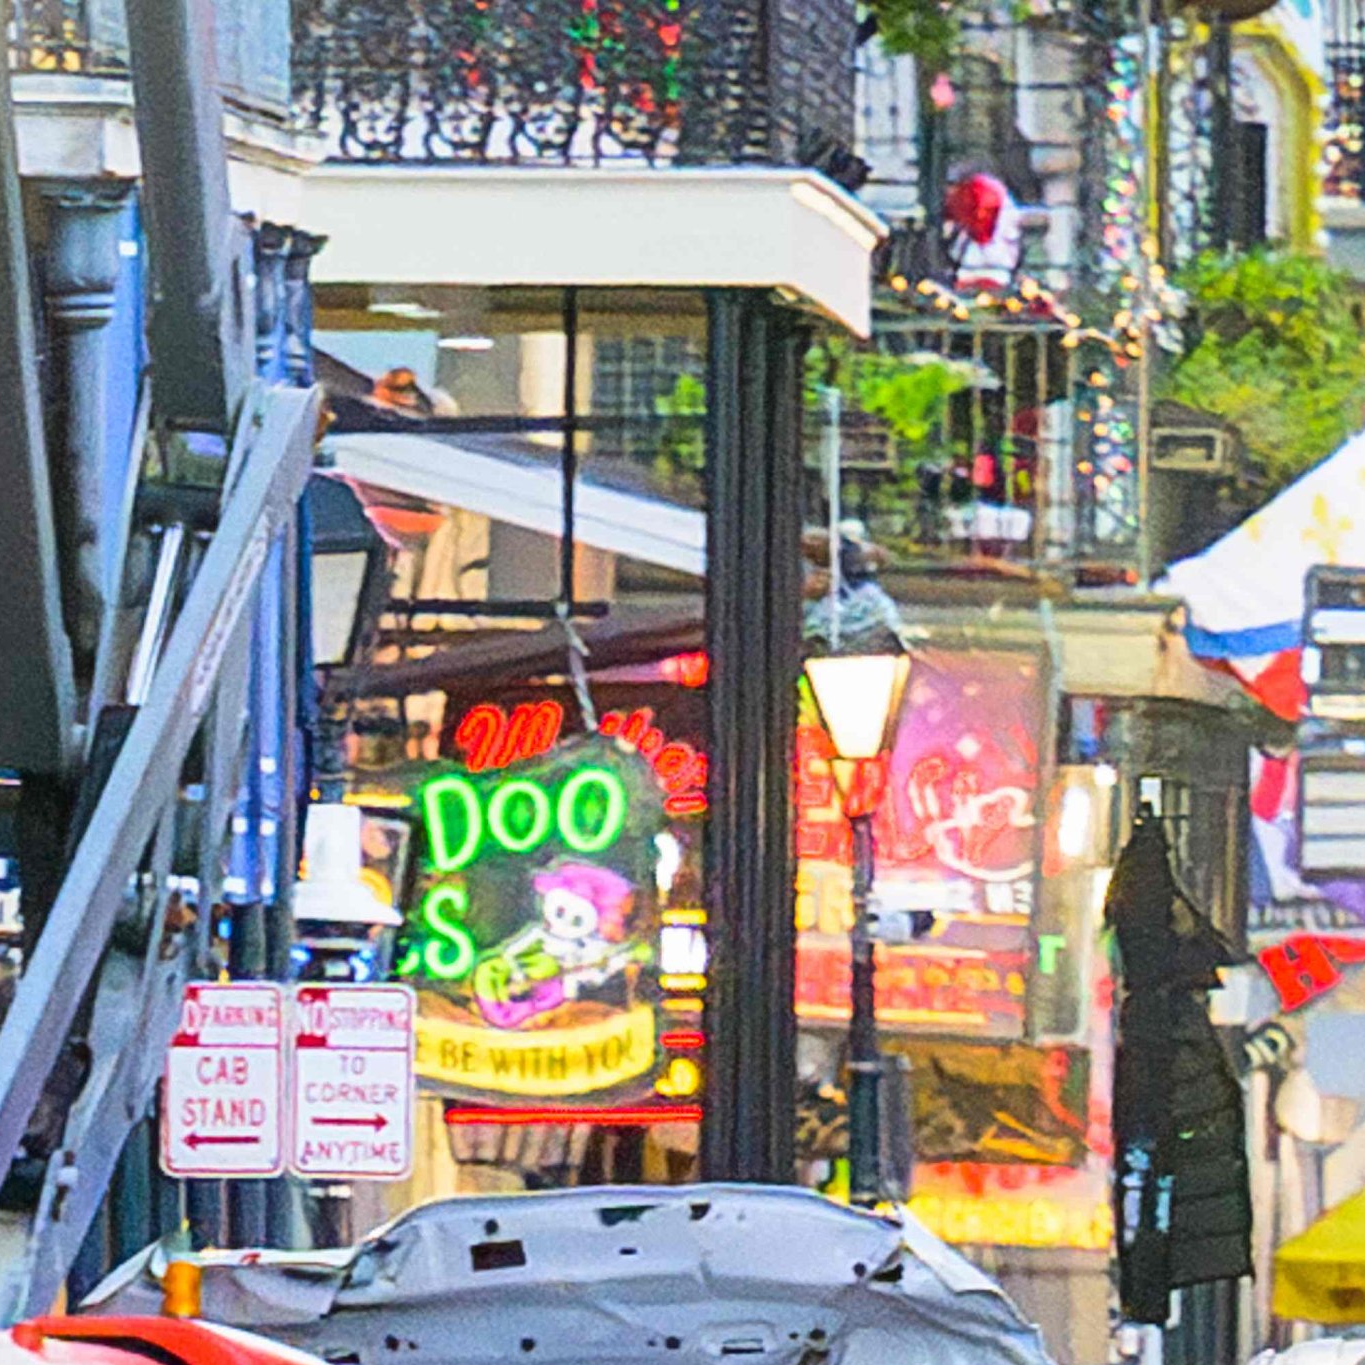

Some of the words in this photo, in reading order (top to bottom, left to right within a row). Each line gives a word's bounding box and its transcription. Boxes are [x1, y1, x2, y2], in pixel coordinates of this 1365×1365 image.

[196, 1055, 249, 1086] CAB
[337, 1054, 366, 1076] TO
[488, 1048, 567, 1080] WITH
[303, 1083, 399, 1105] CORNER
[181, 1098, 266, 1128] STAND
[299, 1140, 402, 1166] ANYTIME
